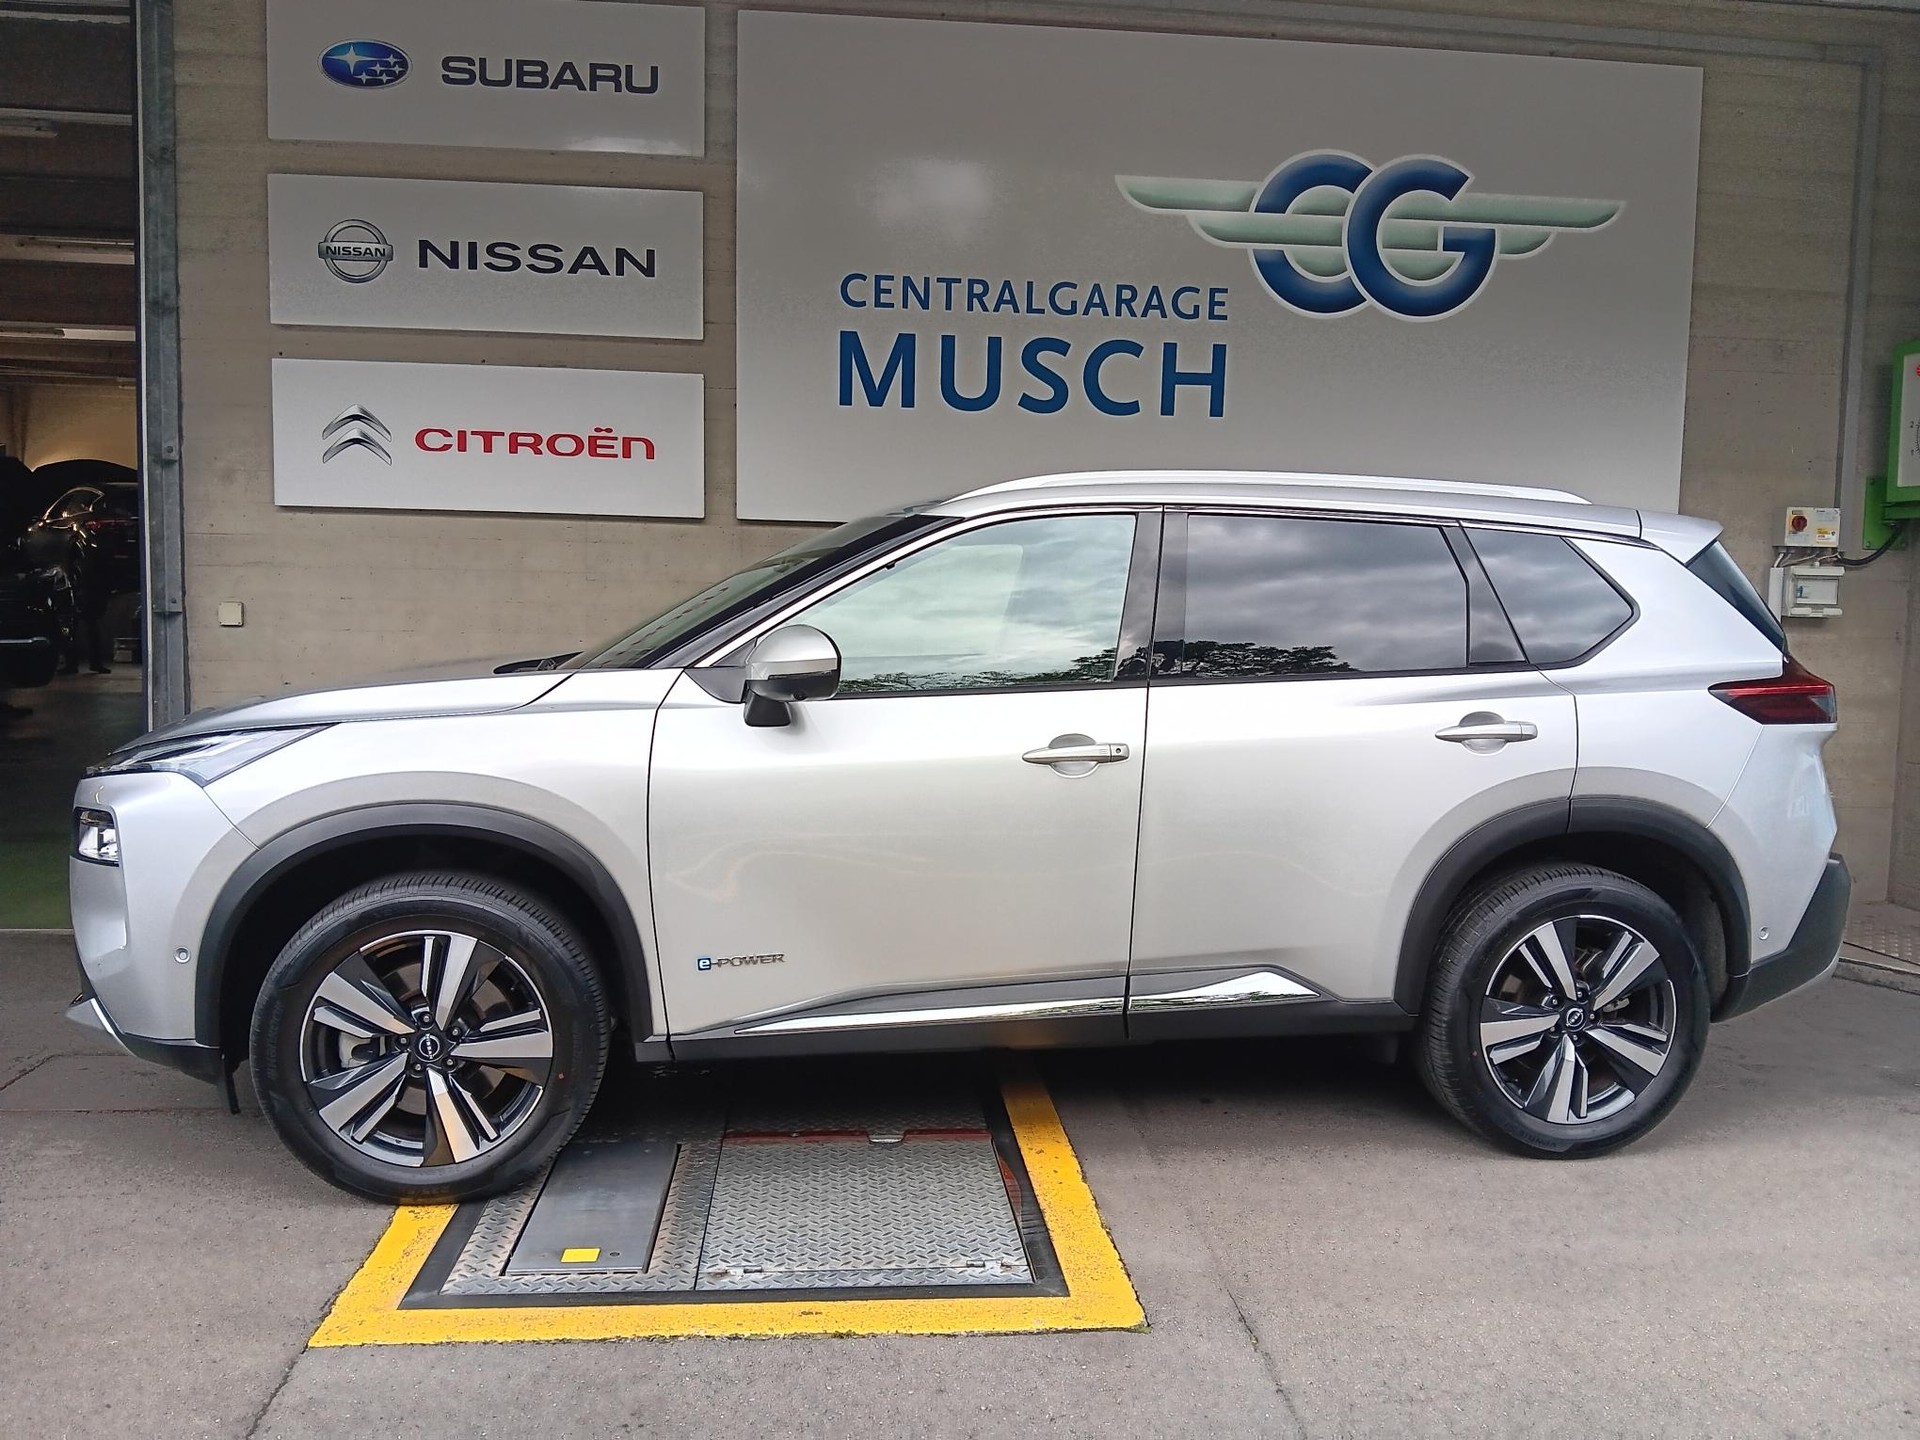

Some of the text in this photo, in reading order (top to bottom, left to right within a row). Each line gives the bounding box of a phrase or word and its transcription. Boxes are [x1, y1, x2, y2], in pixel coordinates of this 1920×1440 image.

[441, 55, 659, 94] SUBARU
[325, 245, 386, 257] NISSAN
[418, 239, 655, 278] NISSAN
[840, 273, 1229, 320] CENTRALGARAGE
[839, 331, 1227, 418] MUSCH
